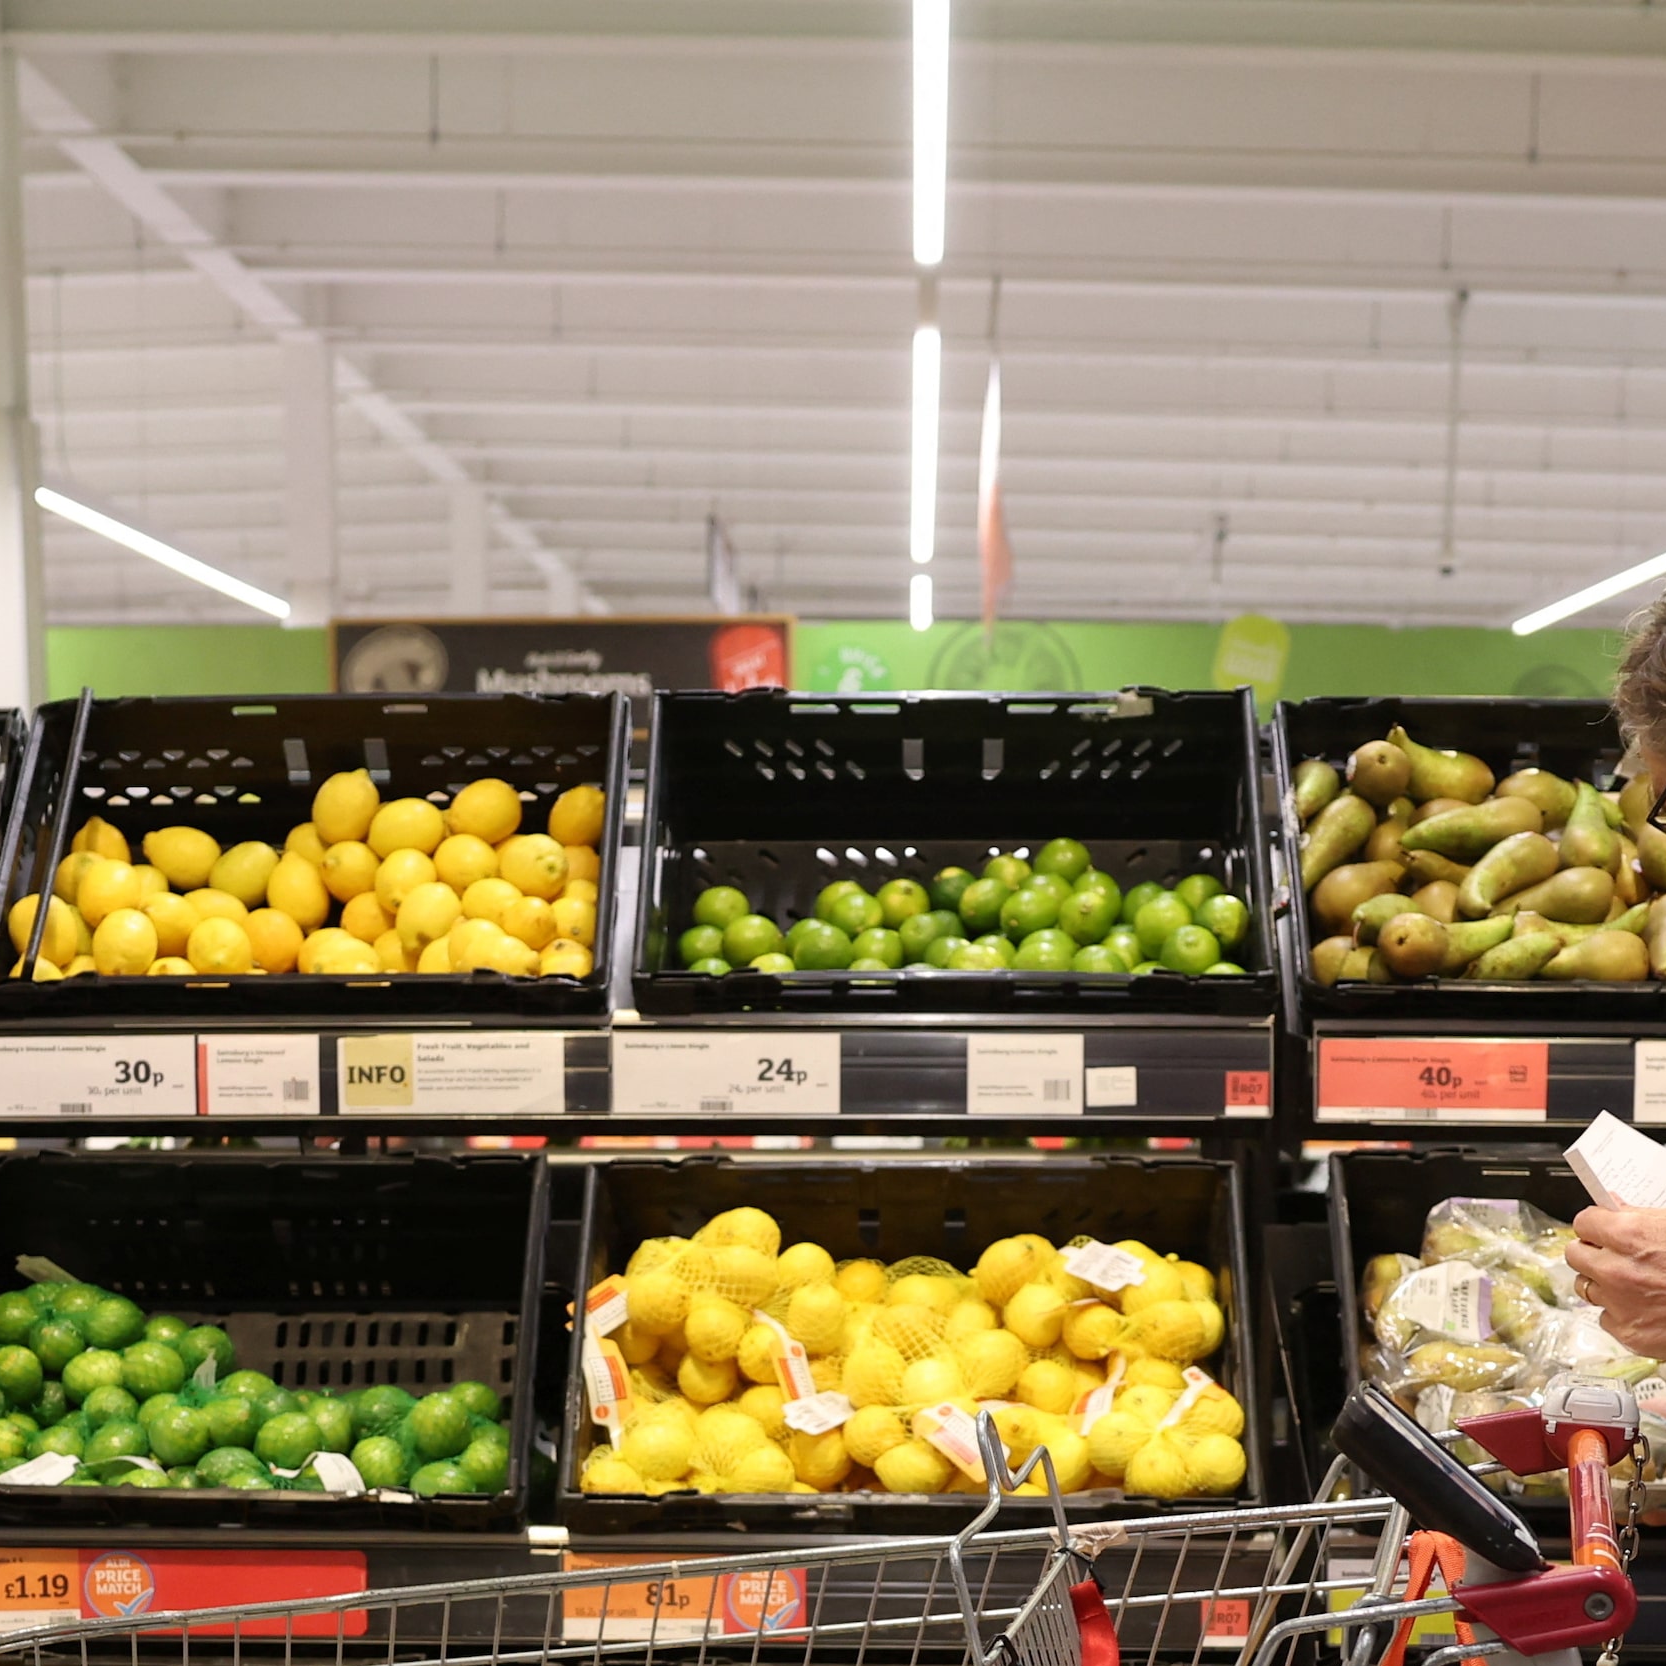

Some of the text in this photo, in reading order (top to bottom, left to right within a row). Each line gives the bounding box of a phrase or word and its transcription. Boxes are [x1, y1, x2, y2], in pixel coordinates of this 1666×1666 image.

[114, 1060, 164, 1087] 30p
[757, 1058, 807, 1085] 24p
[1419, 1066, 1462, 1089] 40p
[105, 1087, 121, 1097] per
[123, 1086, 143, 1095] unit
[746, 1085, 763, 1095] per
[765, 1083, 786, 1093] unit
[1440, 1091, 1457, 1101] per
[1459, 1090, 1481, 1099] unit
[106, 1558, 131, 1569] ALDI
[95, 1570, 142, 1583] PRICE
[5, 1574, 69, 1600] £1.19
[96, 1584, 141, 1596] MATCH
[739, 1580, 787, 1594] PRICE
[646, 1582, 691, 1611] 81p
[740, 1593, 787, 1605] MATCH
[1217, 1613, 1241, 1624] R07
